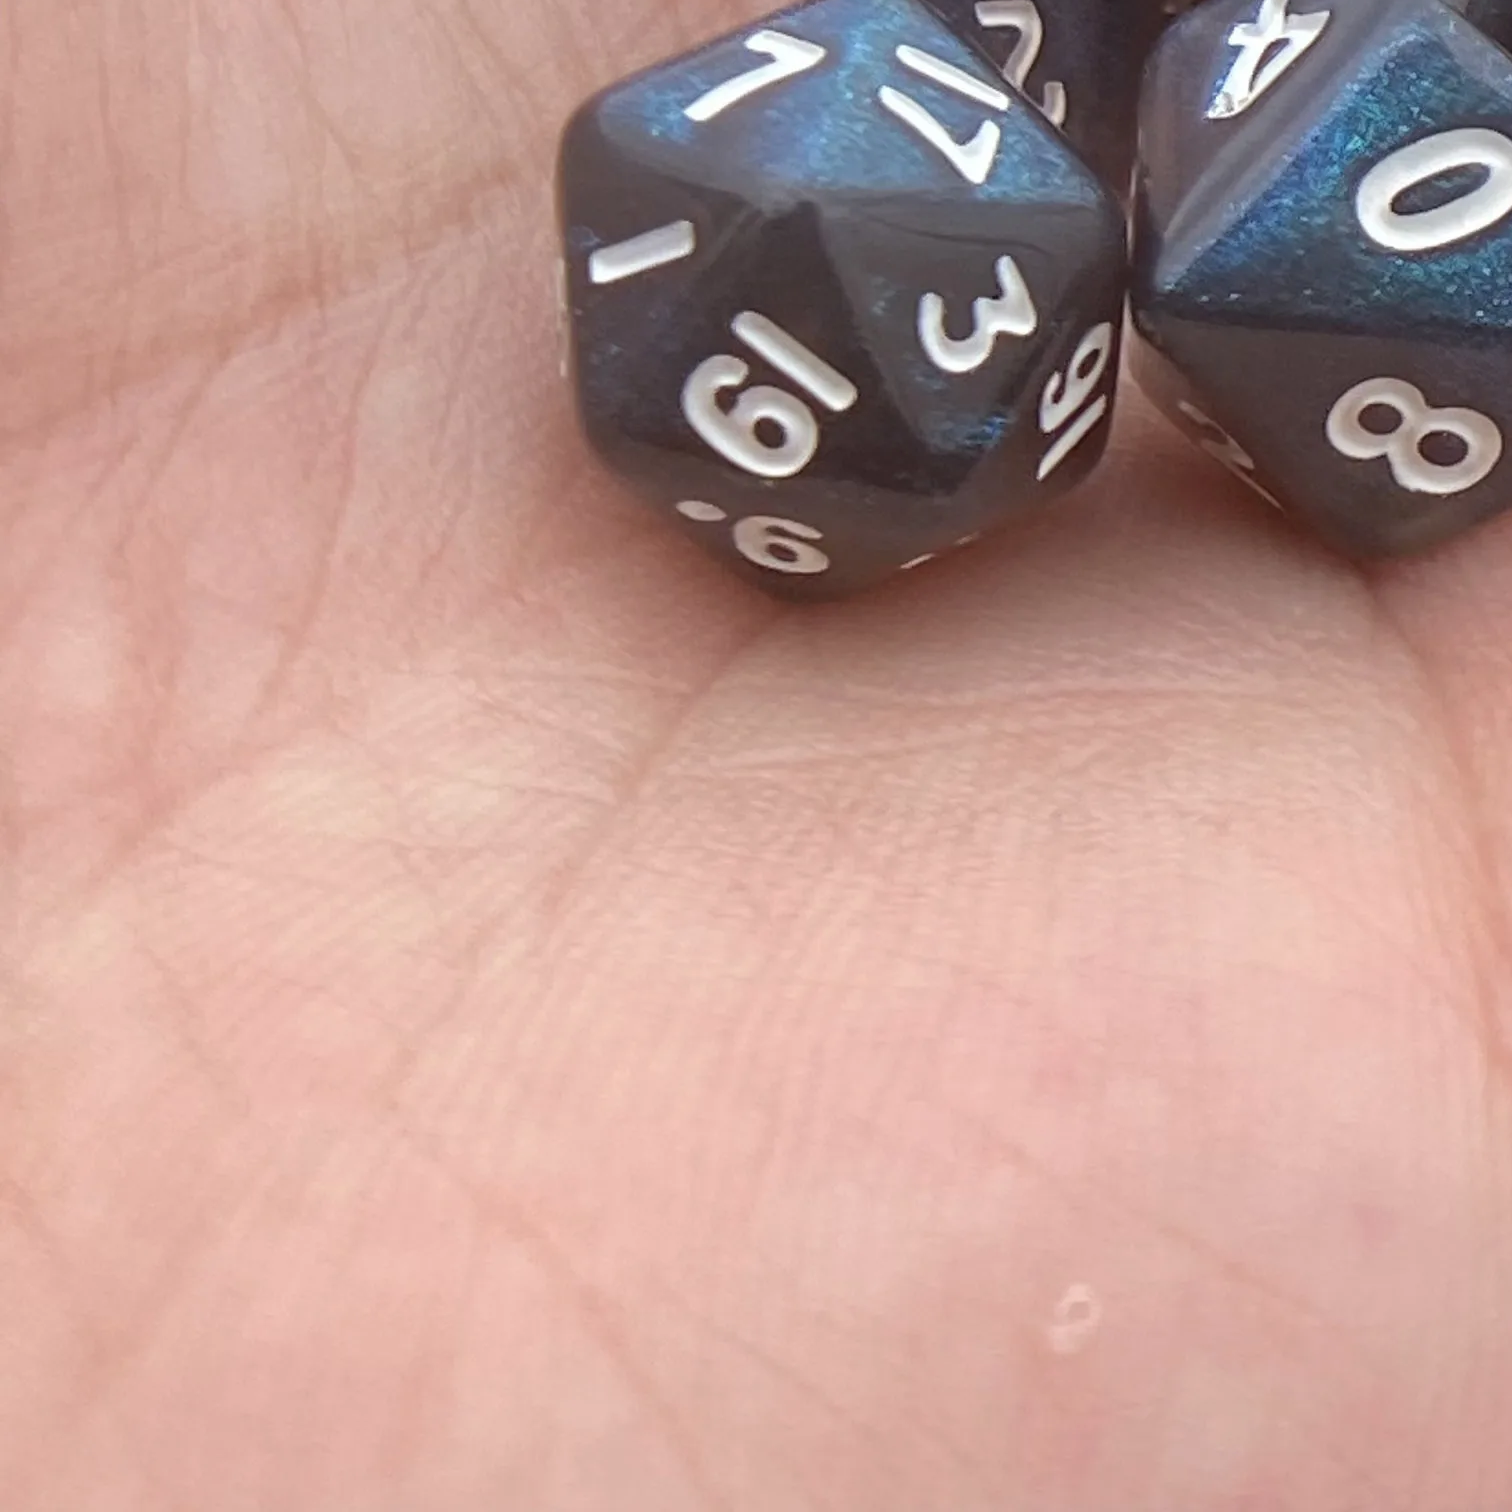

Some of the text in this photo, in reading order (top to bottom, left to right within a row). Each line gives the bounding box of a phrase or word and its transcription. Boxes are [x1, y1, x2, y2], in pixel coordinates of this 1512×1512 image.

[880, 43, 1010, 184] 17
[918, 254, 1037, 373] 3
[680, 310, 858, 478] 19
[1326, 377, 1502, 495] 8
